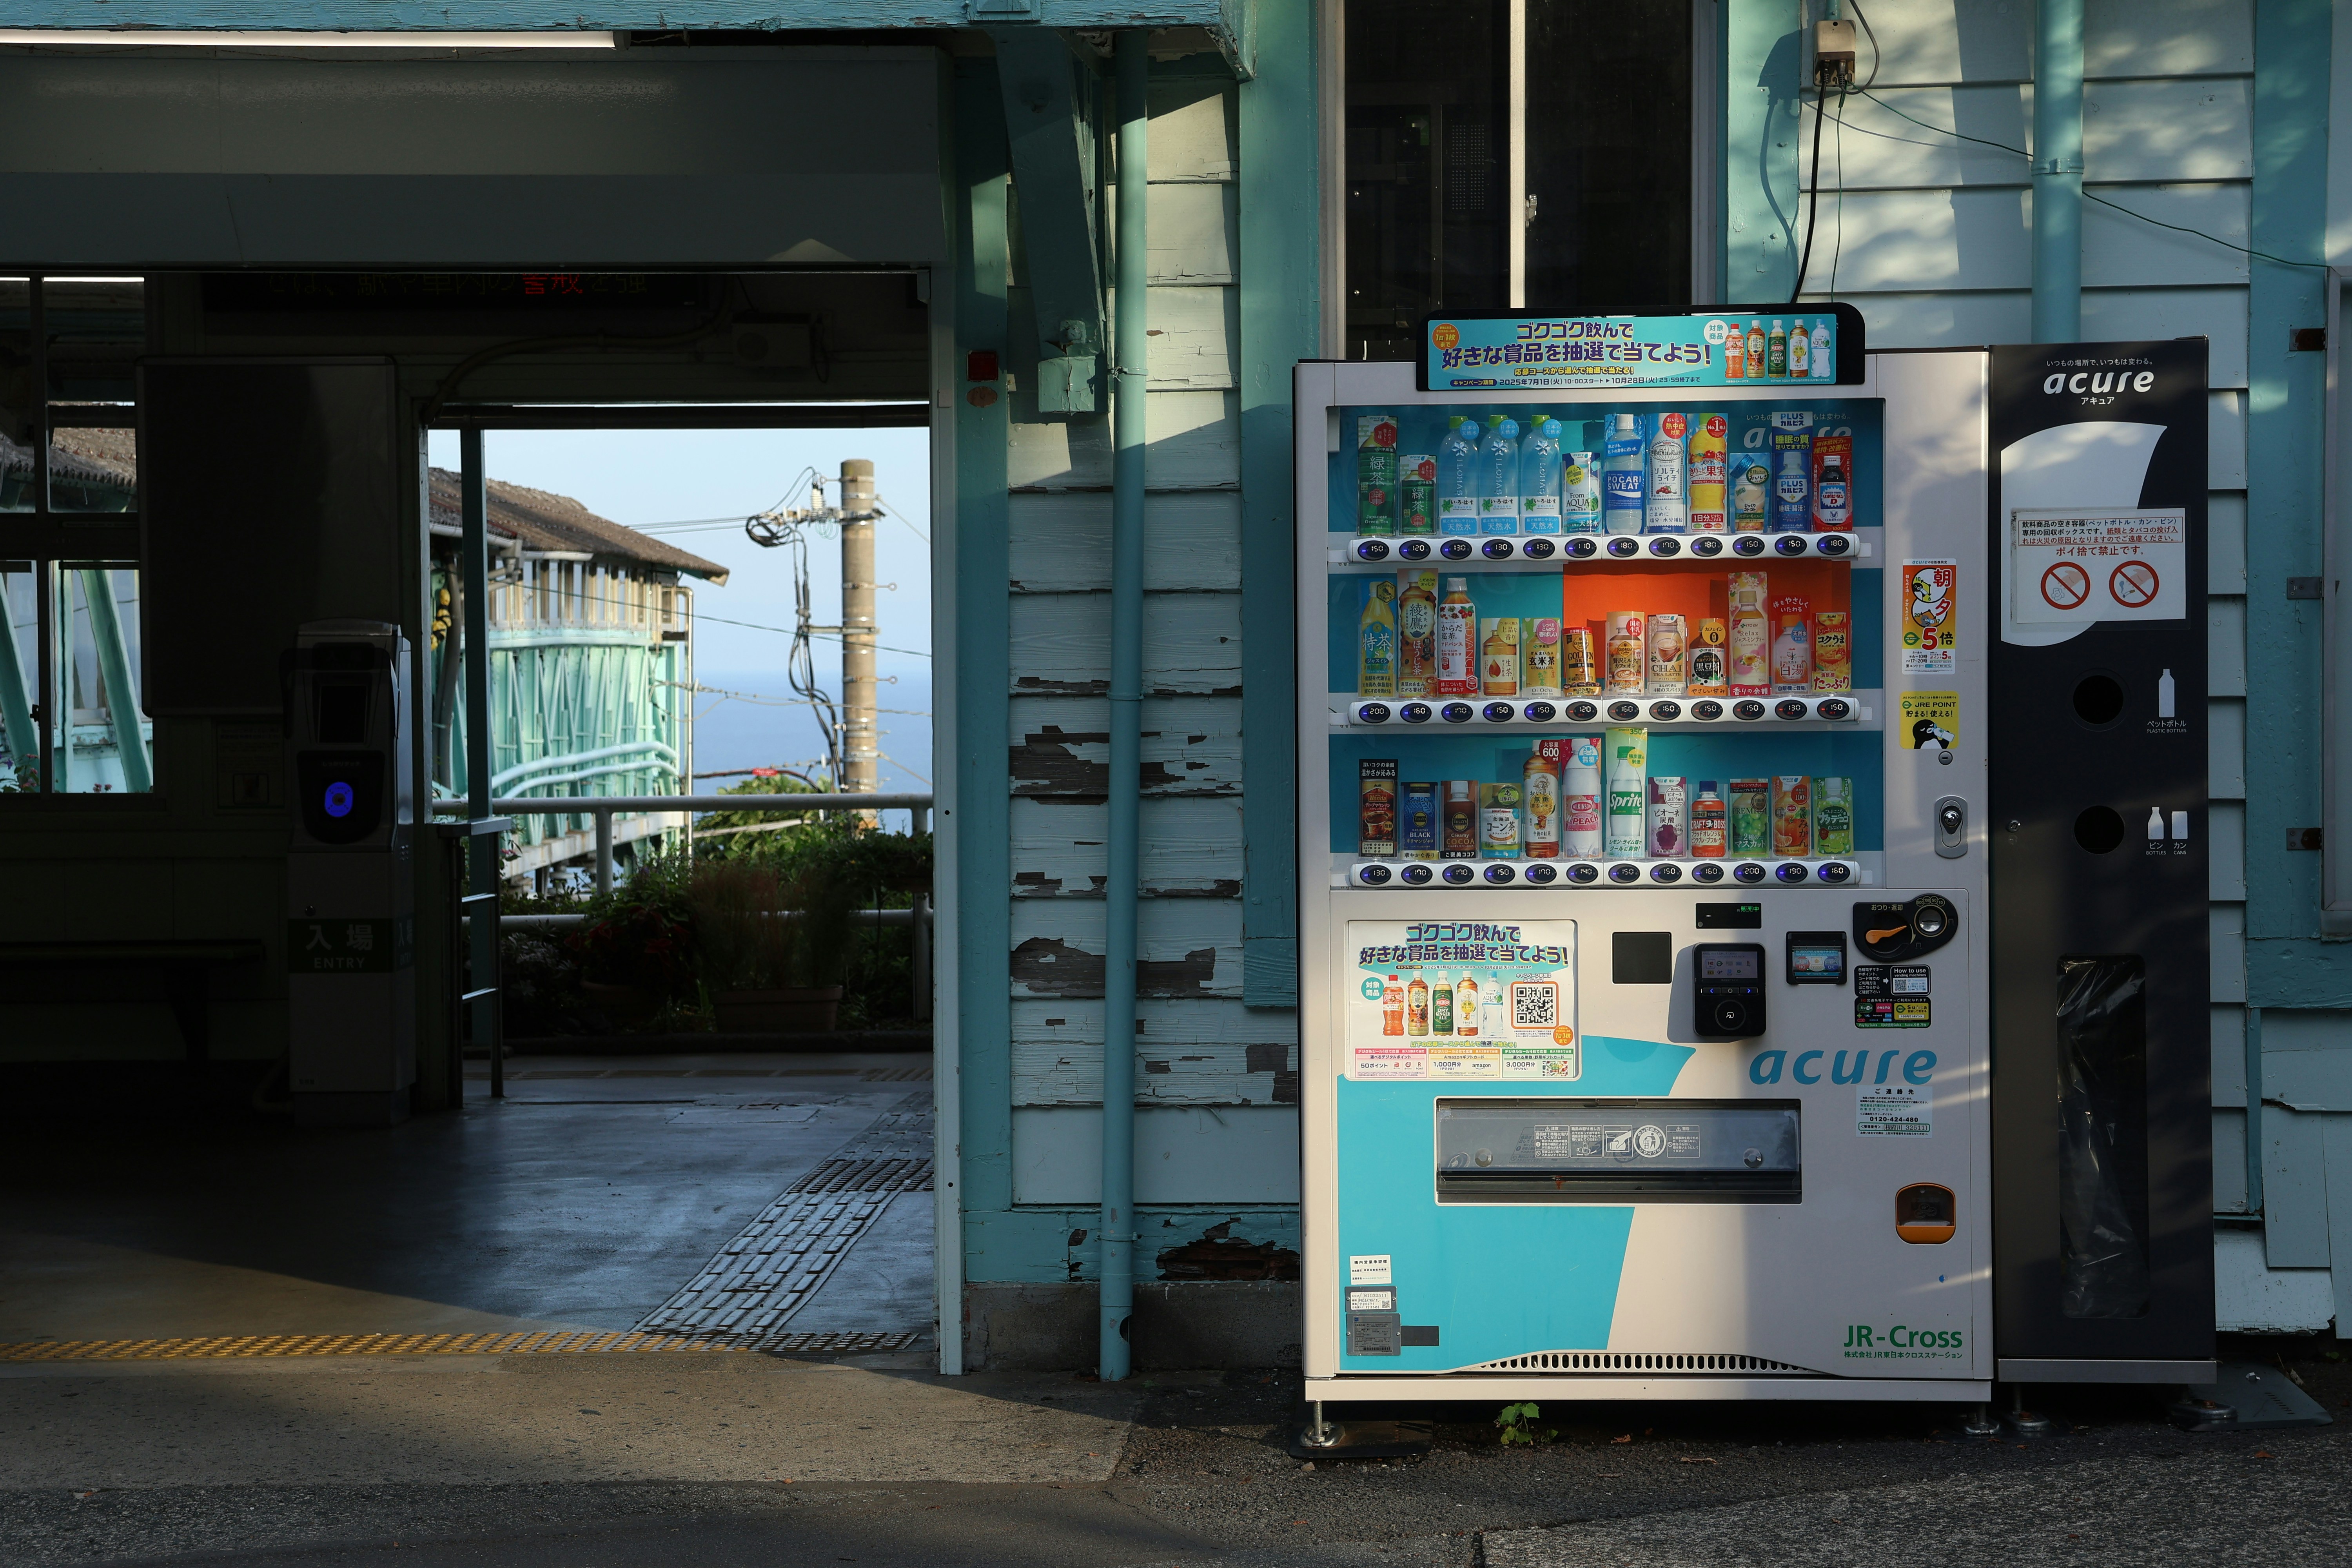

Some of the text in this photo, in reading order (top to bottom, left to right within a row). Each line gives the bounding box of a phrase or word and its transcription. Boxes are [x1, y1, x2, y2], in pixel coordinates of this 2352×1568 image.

[1516, 321, 1633, 340] ゴクゴク飲んで
[1441, 341, 1711, 369] 好きな賞品を抽選で当てよう！
[2046, 358, 2153, 367] いつもの場所で、いつもは変わる。
[1514, 366, 1634, 377] 応募コースから選んで抽選で当たる！
[2043, 371, 2155, 395] acure
[2081, 396, 2115, 405] アキュア
[1775, 434, 1809, 444] 睡眠の質
[1369, 456, 1385, 486] 緑茶
[1411, 487, 1424, 512] 緑茶
[2056, 545, 2145, 557] ポイ捨て禁止です。
[1933, 568, 1952, 587] 朝
[1362, 633, 1393, 652] 特茶
[1817, 634, 1845, 645] コクうま
[1412, 640, 1421, 675] ほうじ茶
[1529, 656, 1555, 666] 玄米茶
[1695, 662, 1720, 672] 黒豆茶
[1780, 663, 1803, 676] 白湯
[1814, 676, 1849, 691] たっぷり
[1732, 687, 1768, 695] 香りの余韻
[1542, 748, 1559, 757] 600
[1572, 802, 1592, 811] WILKINSON
[1610, 793, 1642, 810] Sprite
[1572, 814, 1599, 825] PEACH
[1653, 809, 1680, 817] ピオーネ
[1818, 811, 1849, 825] ナタデココ
[1486, 821, 1515, 832] コーン茶
[1691, 820, 1726, 829] CRAFT BOSS
[305, 924, 373, 951] 入場
[1406, 923, 1521, 943] ゴクゴク飲んで
[1359, 944, 1568, 965] 好きな賞品を抽選で当てよう！
[314, 957, 365, 969] ENTRY
[1749, 1049, 1937, 1085] acure
[1844, 1325, 1963, 1348] JR-Cross
